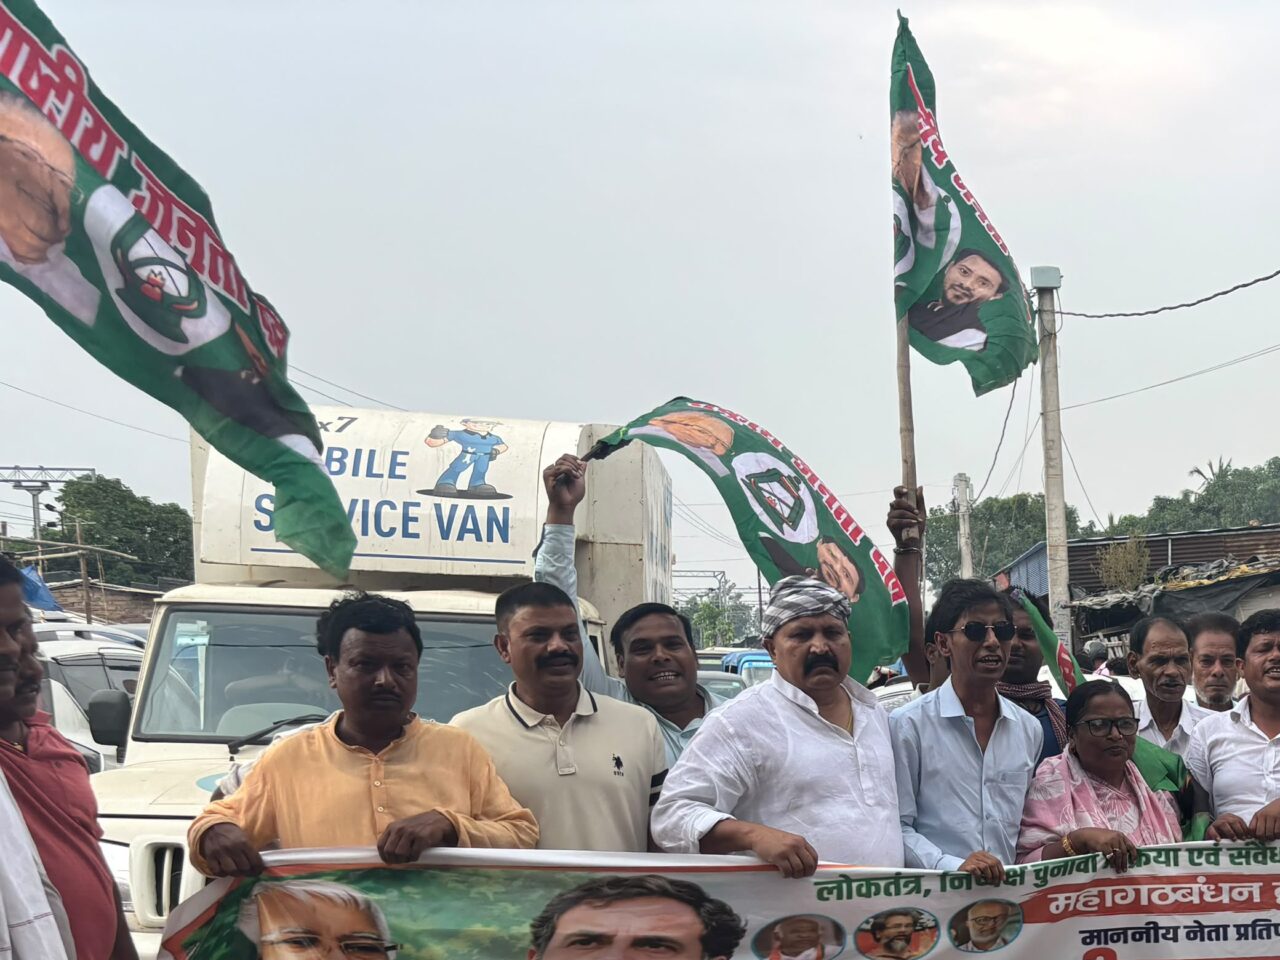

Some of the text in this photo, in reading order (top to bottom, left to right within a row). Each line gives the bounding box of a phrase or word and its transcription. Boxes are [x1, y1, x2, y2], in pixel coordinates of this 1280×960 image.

[325, 446, 410, 480] BILE
[254, 493, 510, 544] SICE VAN
[814, 873, 932, 902] लोकतंत्र,
[1188, 841, 1222, 867] एवं
[1048, 875, 1261, 915] महागठबंधन
[1078, 921, 1180, 946] माननीय
[1185, 920, 1230, 943] नेता
